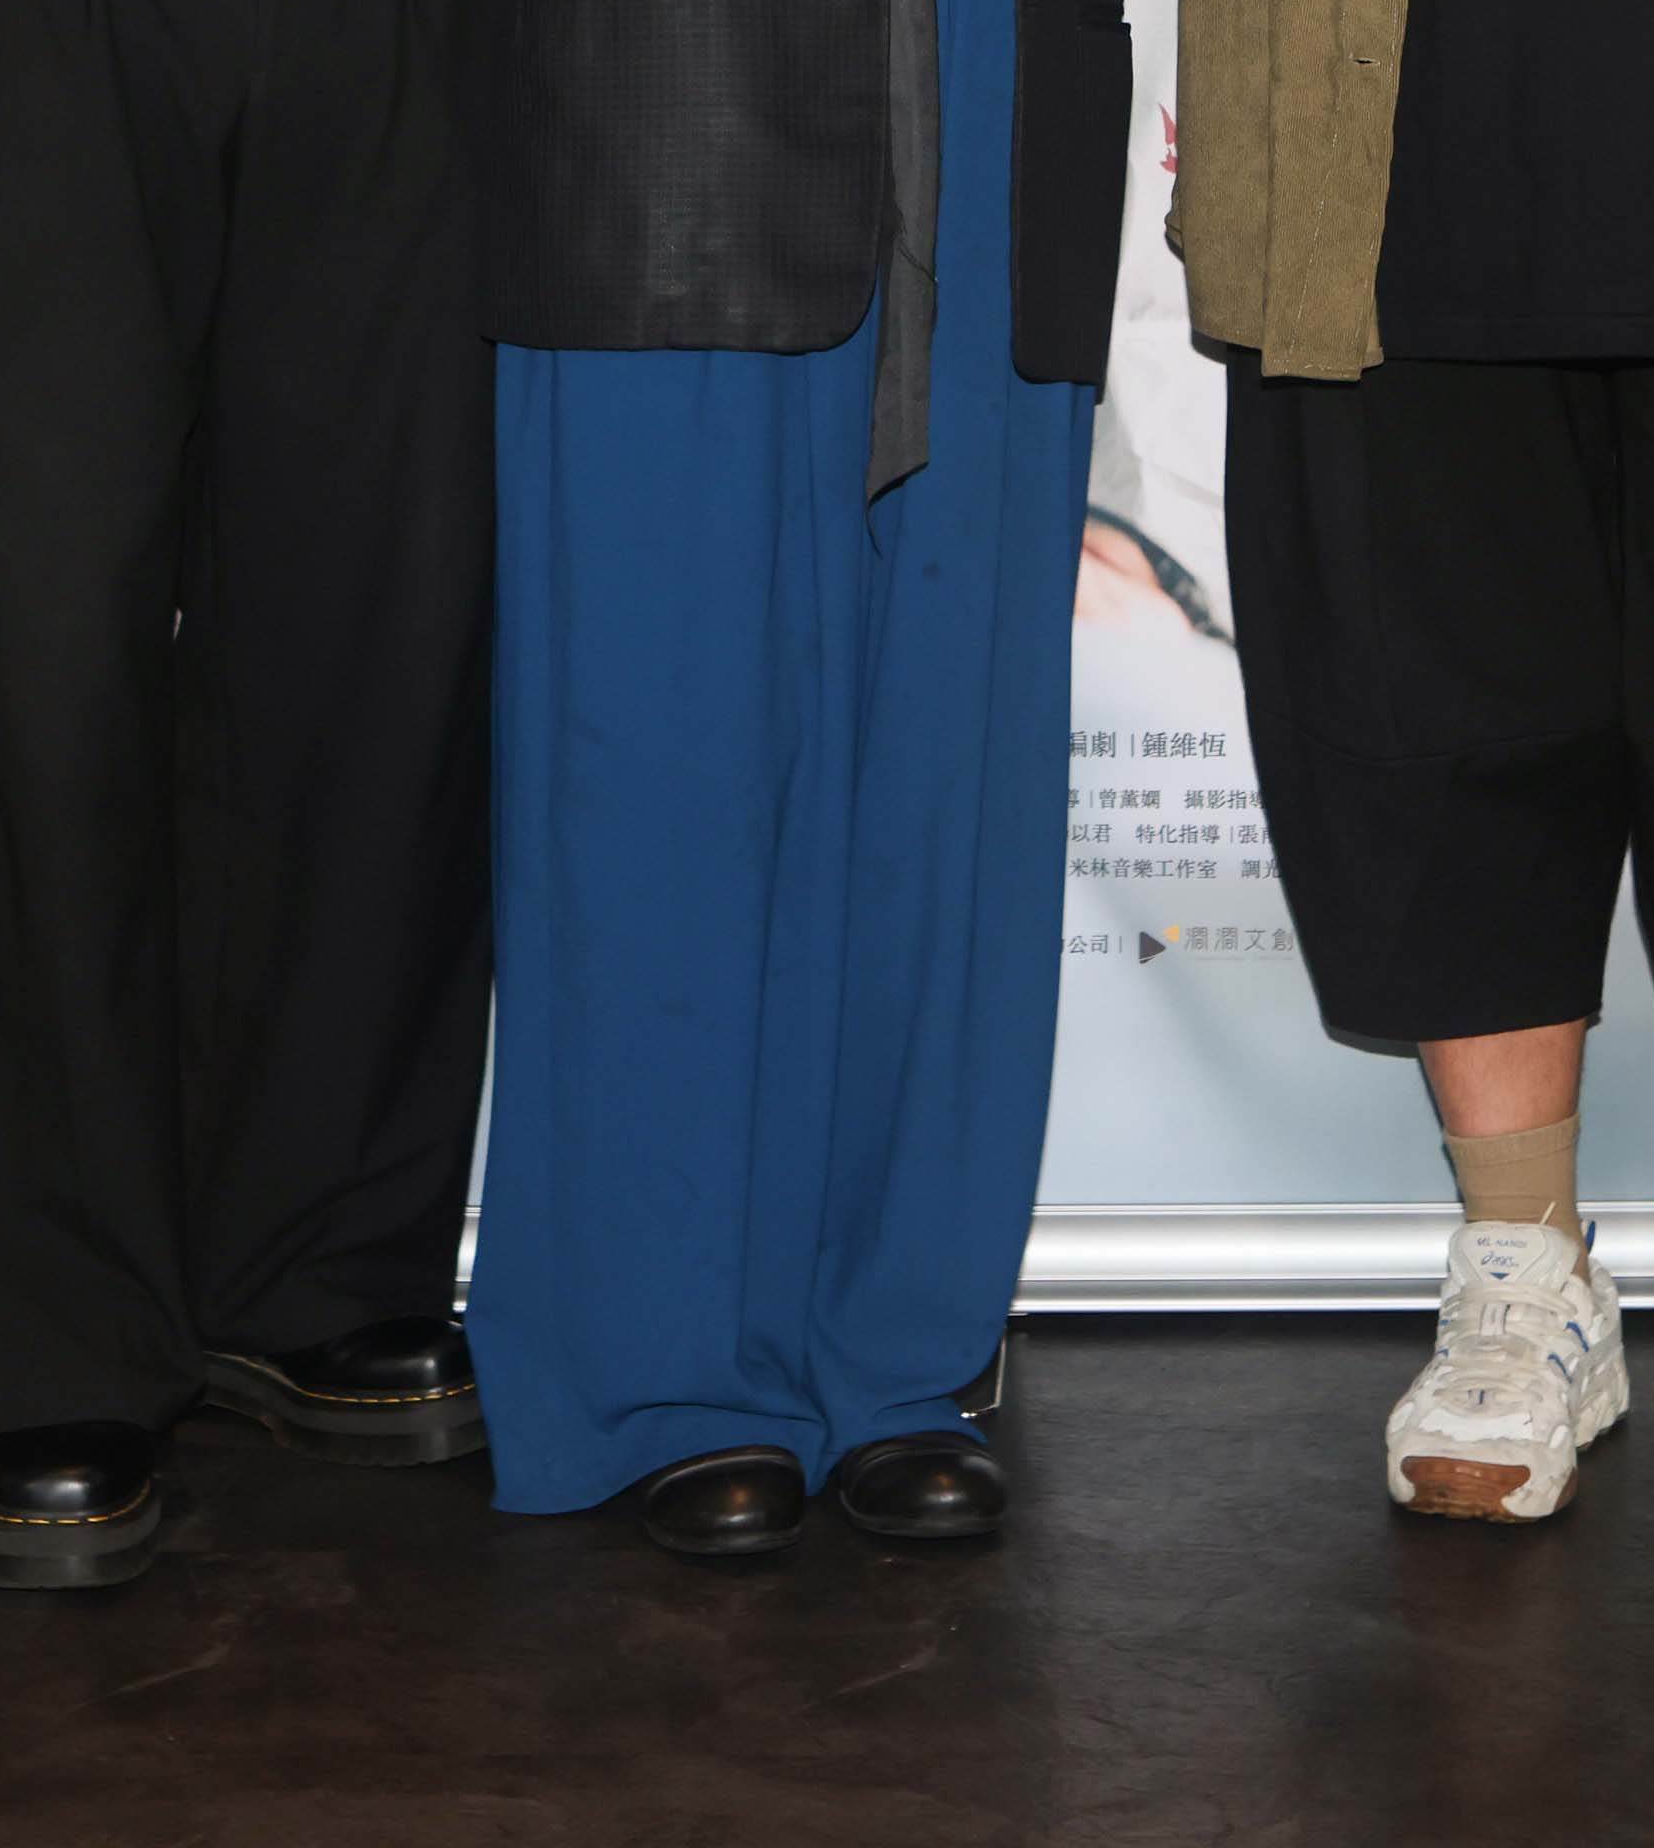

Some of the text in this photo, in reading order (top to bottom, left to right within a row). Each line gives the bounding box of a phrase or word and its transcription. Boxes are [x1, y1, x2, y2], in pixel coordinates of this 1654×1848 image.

[1135, 824, 1221, 845] 特化指導
[1062, 934, 1109, 955] 公司
